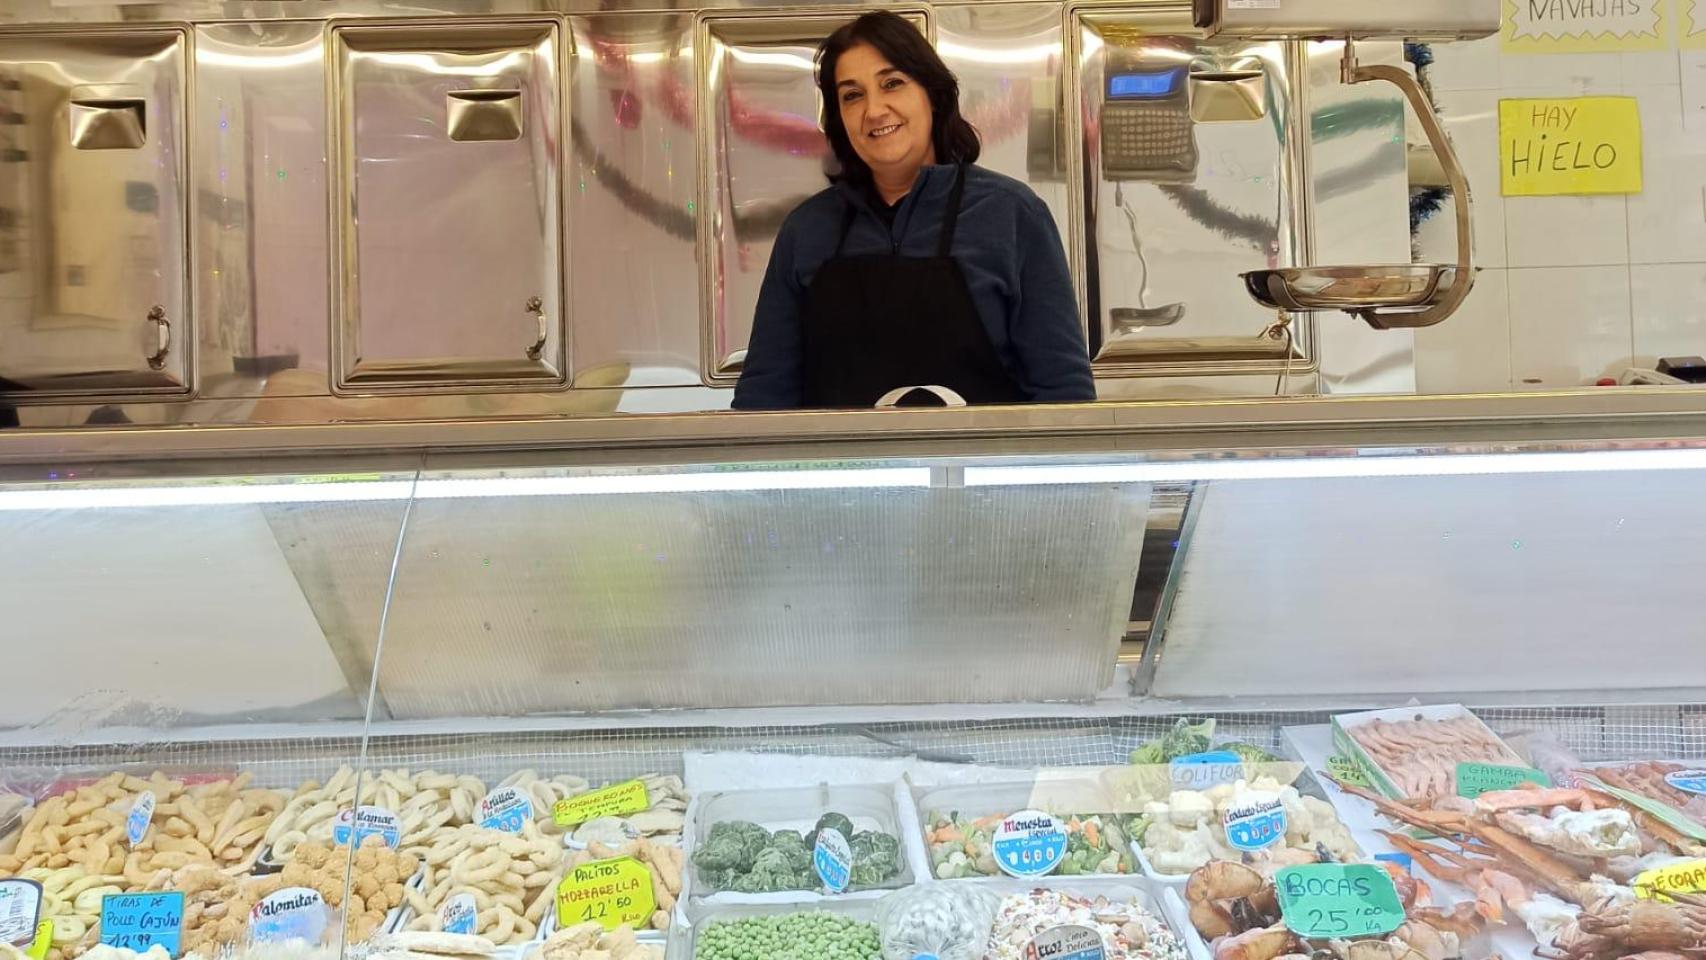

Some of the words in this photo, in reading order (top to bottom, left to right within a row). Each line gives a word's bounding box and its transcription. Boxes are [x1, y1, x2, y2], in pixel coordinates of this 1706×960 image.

[1528, 0, 1640, 22] NAVAJAS
[1531, 104, 1577, 132] HAY
[1004, 816, 1053, 833] Menestra
[560, 878, 640, 905] MOZZARELLA
[1286, 873, 1371, 897] BOCAS
[106, 896, 142, 908] TIRAS
[150, 896, 168, 907] DE
[106, 911, 136, 927] POLLO
[139, 910, 181, 929] CAJÚN
